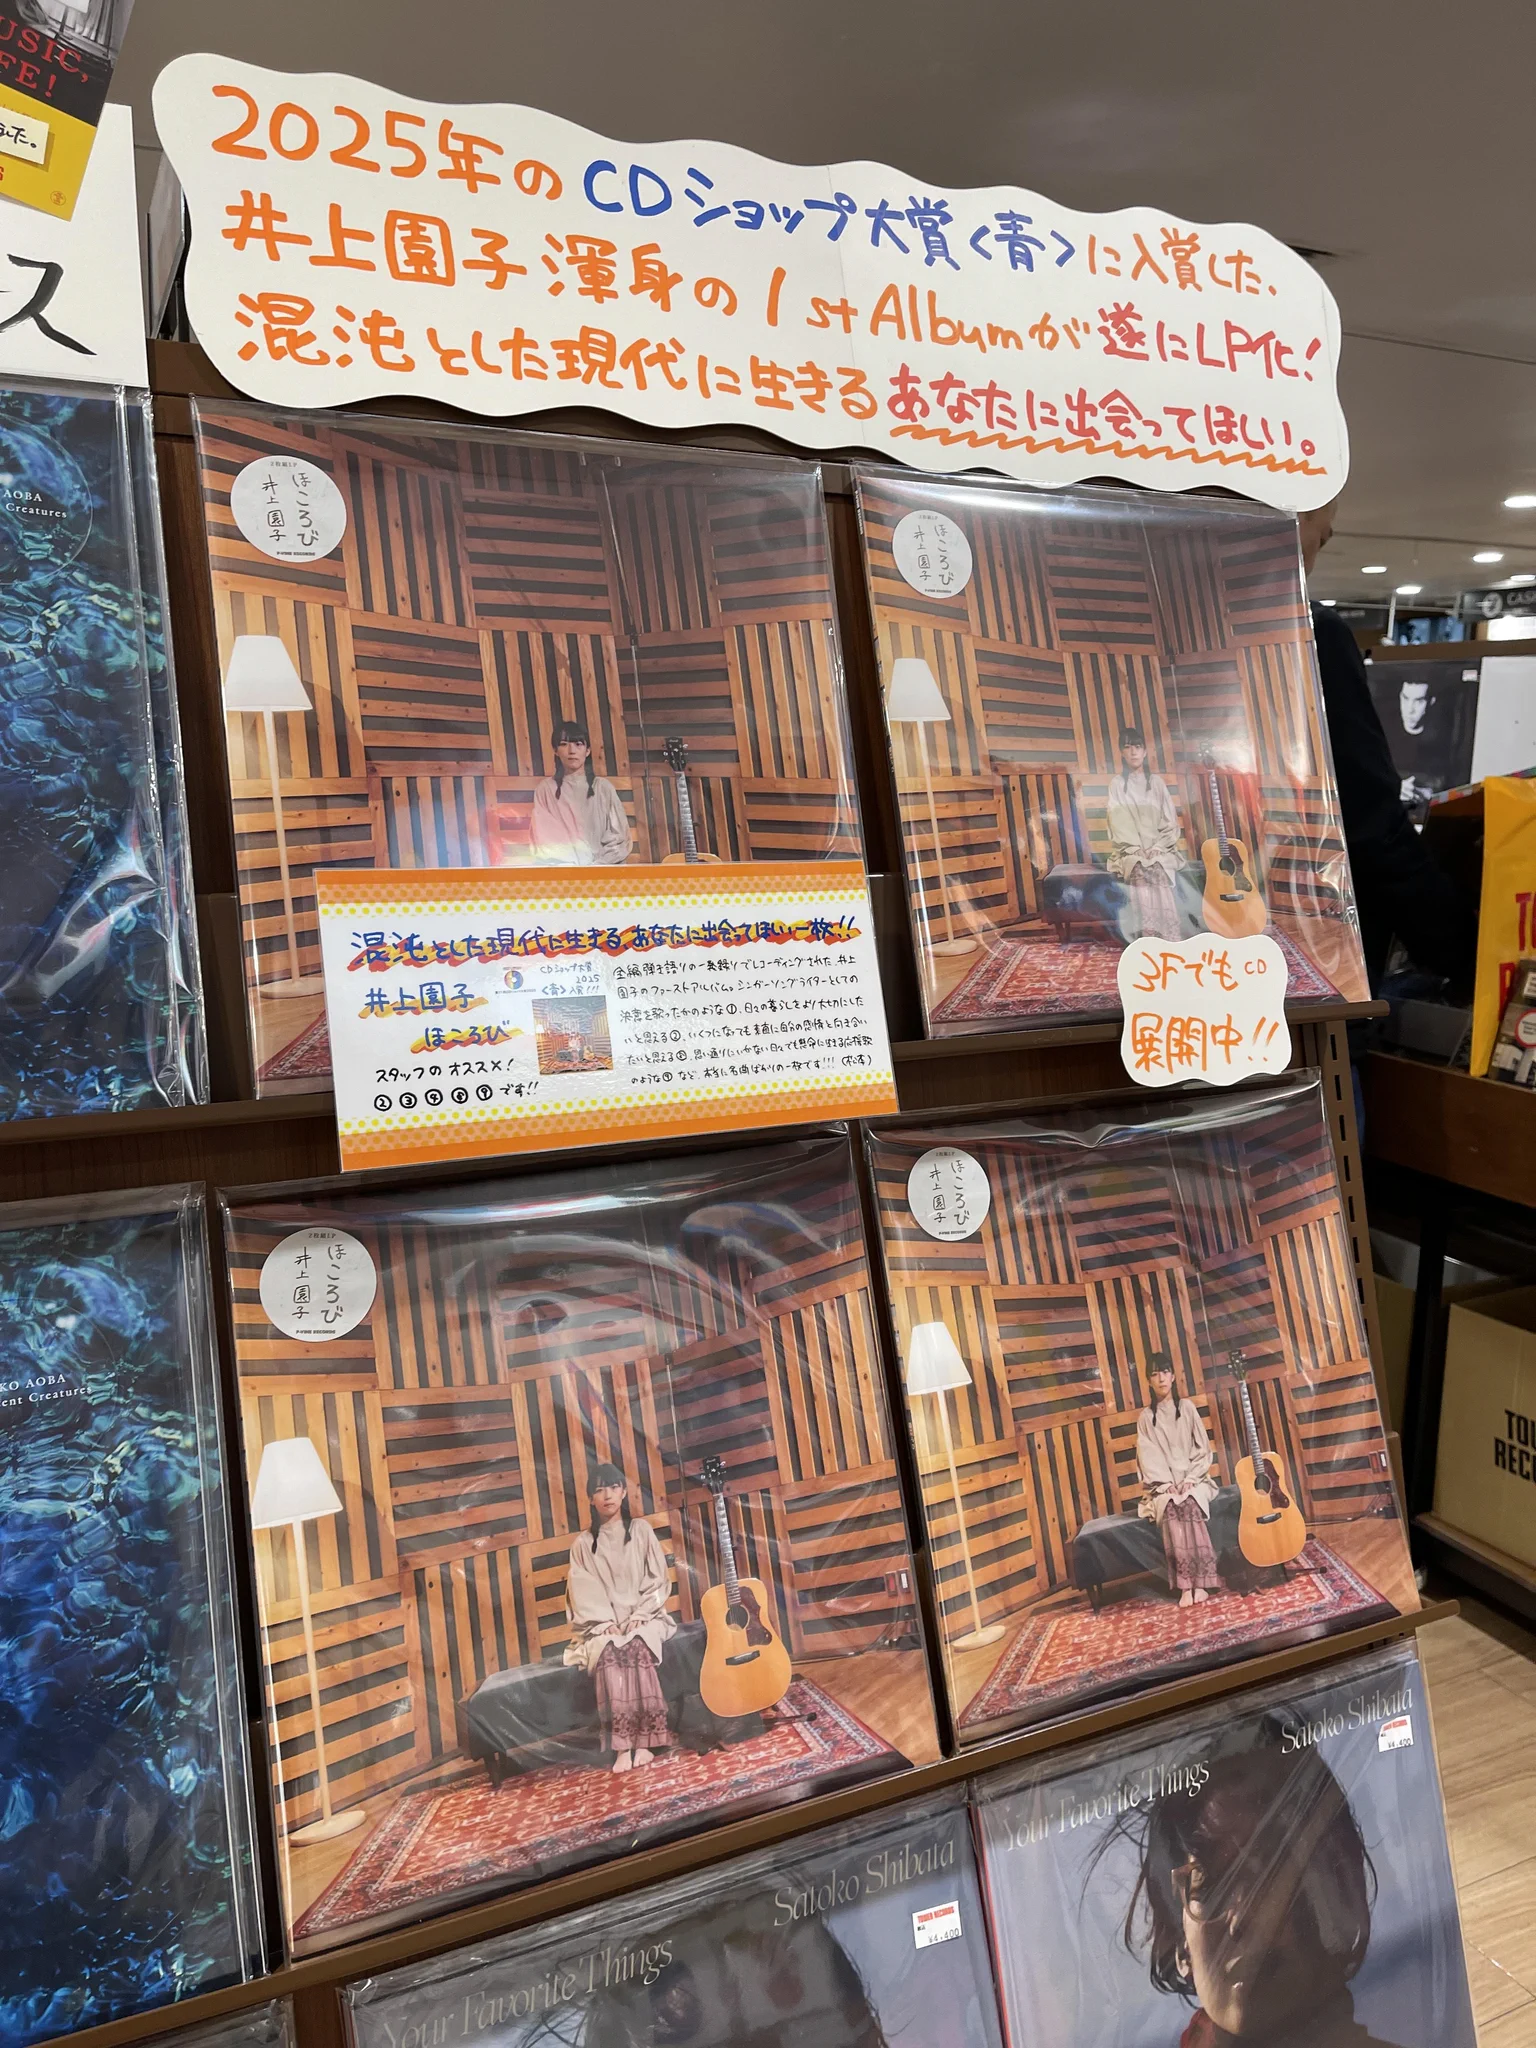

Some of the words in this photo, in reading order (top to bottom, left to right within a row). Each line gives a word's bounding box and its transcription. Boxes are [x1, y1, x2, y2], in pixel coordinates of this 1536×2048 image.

[3, 489, 42, 502] AOBA
[5, 503, 67, 518] Creatures
[262, 474, 286, 541] 井上園子
[292, 472, 319, 546] ほころび
[934, 524, 954, 585] ほころび
[365, 981, 475, 1013] 井上園子
[576, 974, 600, 984] 2025
[425, 1020, 511, 1047] ほころび
[951, 1160, 970, 1225] ほころび
[292, 1246, 311, 1319] 井上園子
[321, 1244, 346, 1323] ほころび
[26, 1373, 66, 1389] AOBA
[29, 1387, 92, 1402] Creatures
[1282, 1708, 1344, 1754] Satoko
[1348, 1688, 1413, 1730] Shibata
[1058, 1783, 1141, 1834] Favorite
[1142, 1759, 1210, 1801] Things
[774, 1869, 860, 1926] Satoko
[865, 1840, 956, 1894] Shibata
[460, 1969, 576, 2036] Favorite
[579, 1939, 673, 1994] Things
